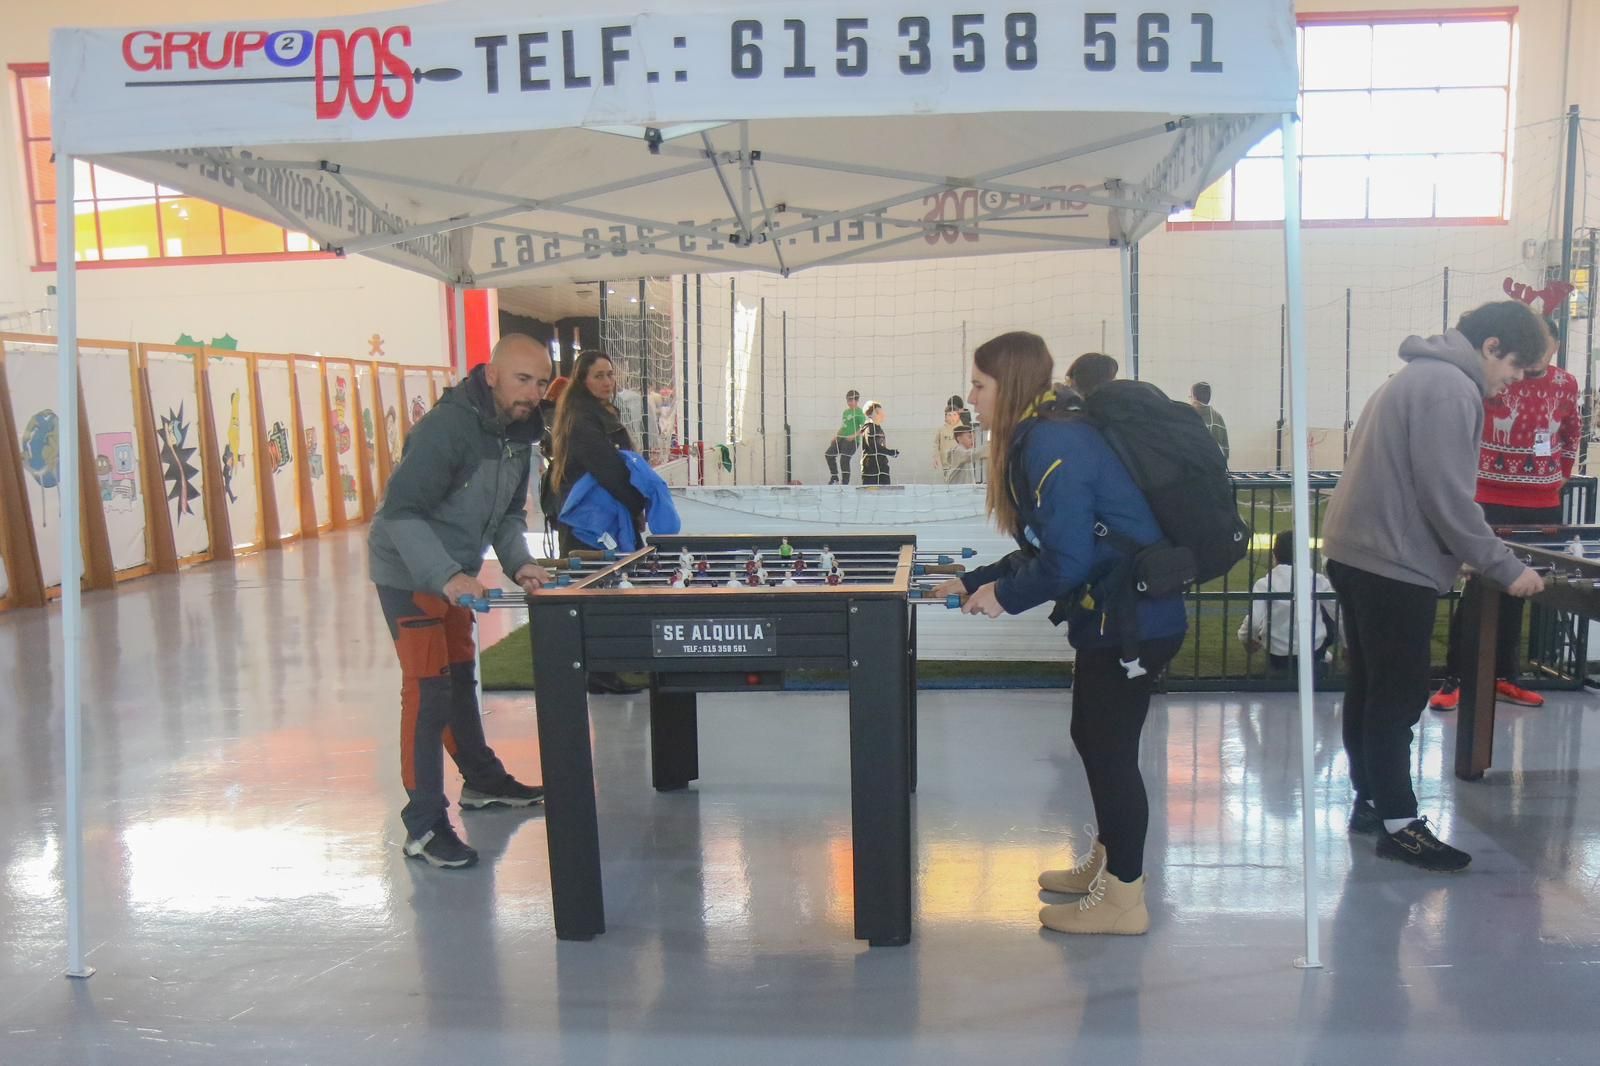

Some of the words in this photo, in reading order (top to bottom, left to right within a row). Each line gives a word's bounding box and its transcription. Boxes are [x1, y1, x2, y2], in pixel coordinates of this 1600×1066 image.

[122, 30, 313, 71] GRUPO
[315, 25, 414, 120] DOS
[474, 25, 688, 94] TELF.:
[731, 18, 868, 79] 615
[898, 12, 1037, 75] 358
[1084, 12, 1223, 73] 561
[663, 625, 684, 641] SE
[692, 624, 764, 641] ALQUILA
[703, 644, 717, 653] 615
